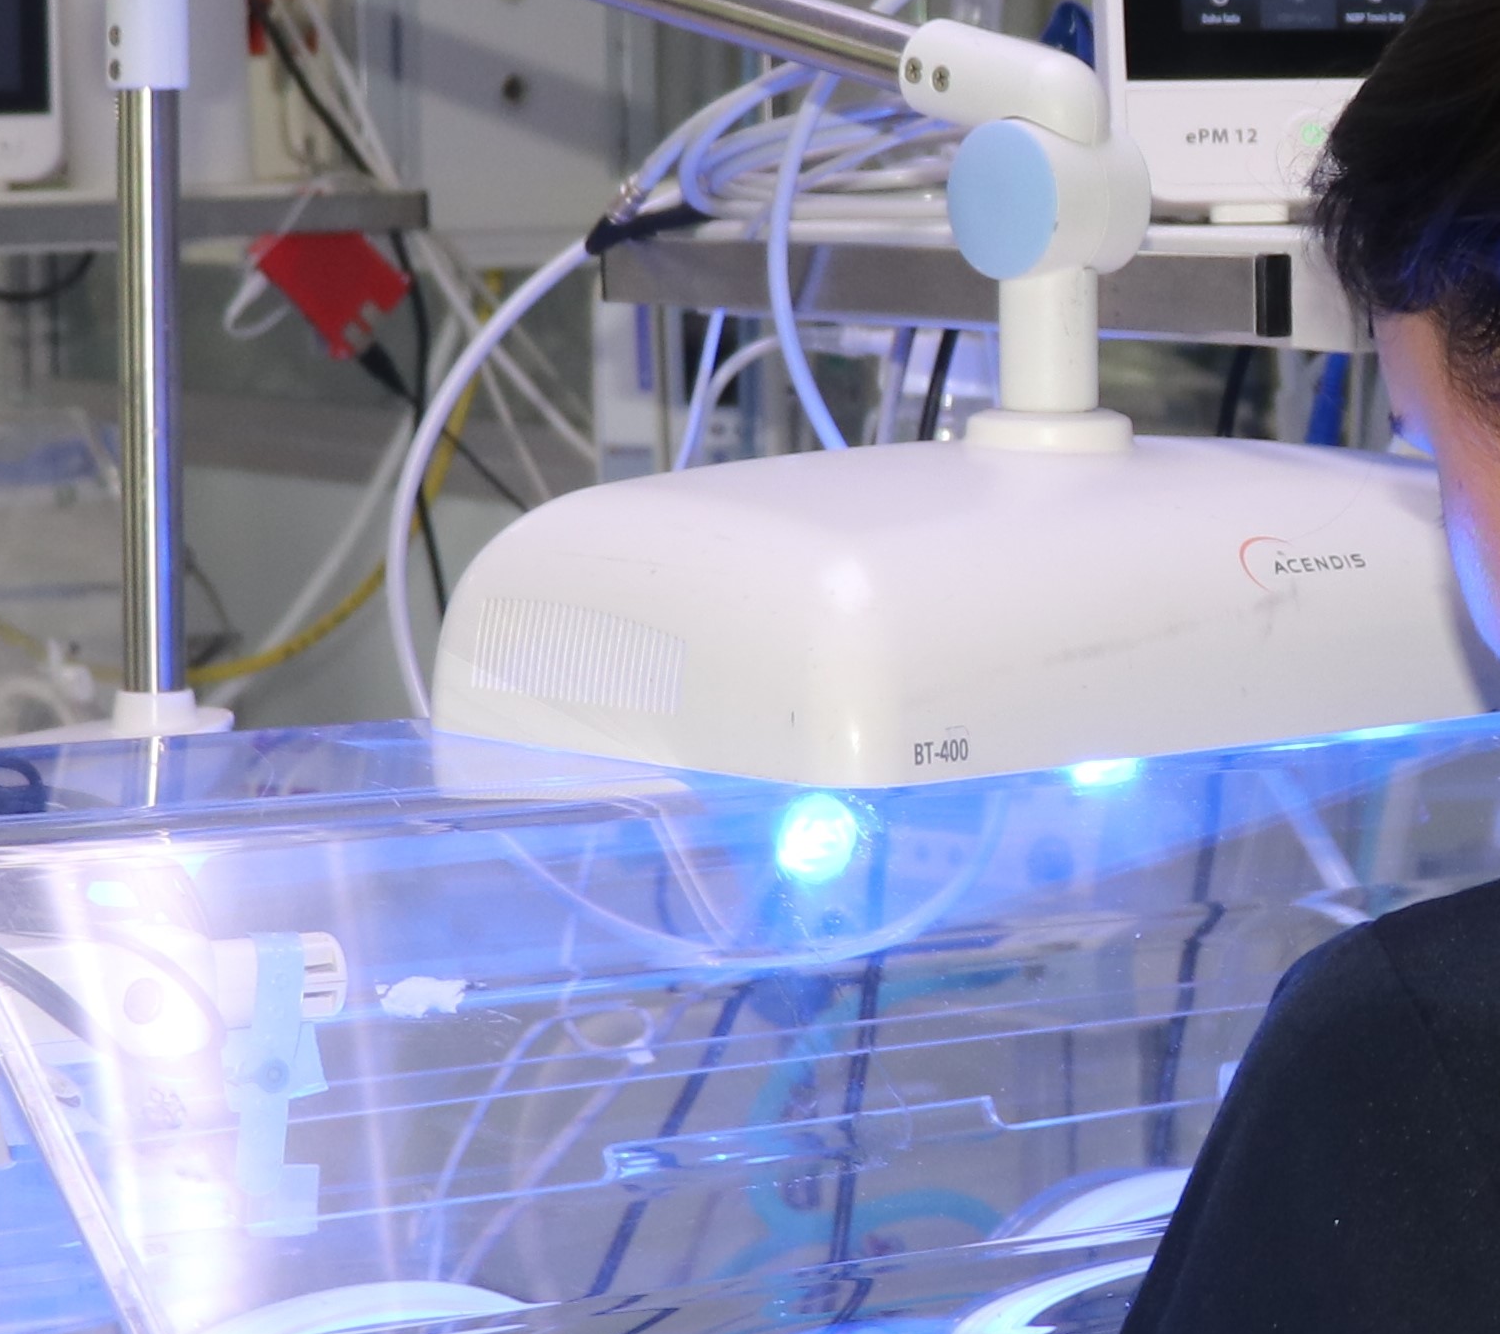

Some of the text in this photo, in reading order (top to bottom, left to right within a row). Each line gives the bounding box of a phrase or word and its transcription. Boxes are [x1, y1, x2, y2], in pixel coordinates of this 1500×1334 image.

[1185, 128, 1258, 144] ePM 12
[1274, 552, 1367, 575] ACENDIS
[914, 738, 969, 766] BT-400
